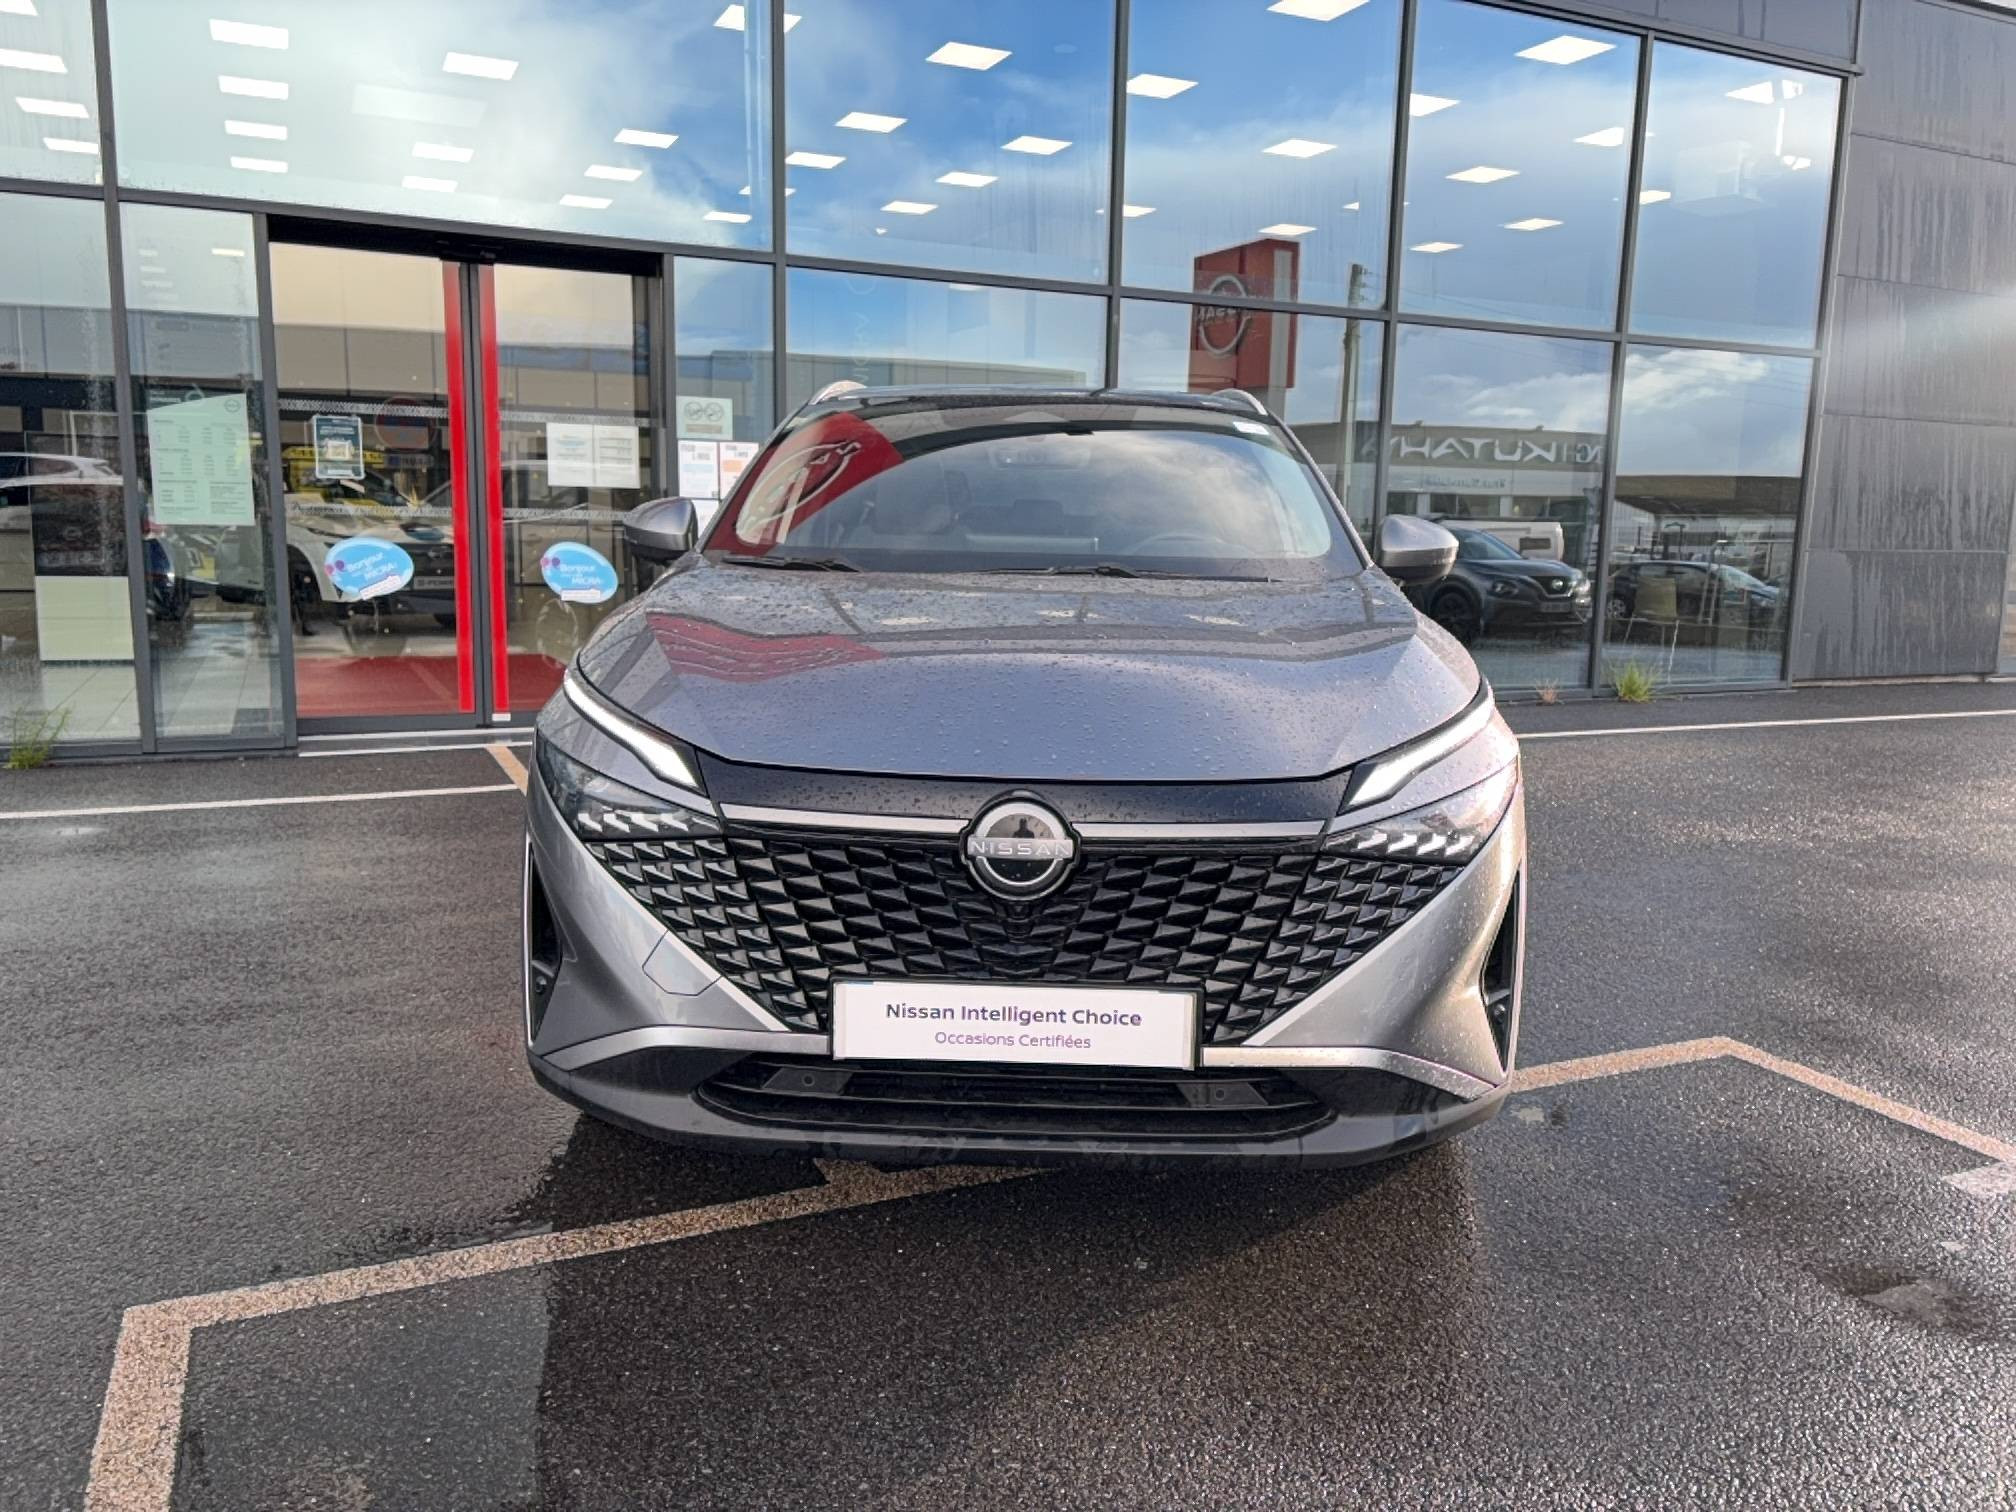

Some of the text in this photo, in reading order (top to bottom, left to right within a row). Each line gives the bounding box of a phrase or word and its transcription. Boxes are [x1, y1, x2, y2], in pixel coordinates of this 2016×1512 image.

[971, 840, 1070, 857] NISSAN
[886, 1002, 1142, 1027] Nissan Intelligent Choice
[934, 1031, 1091, 1049] Occasions Certifiées
